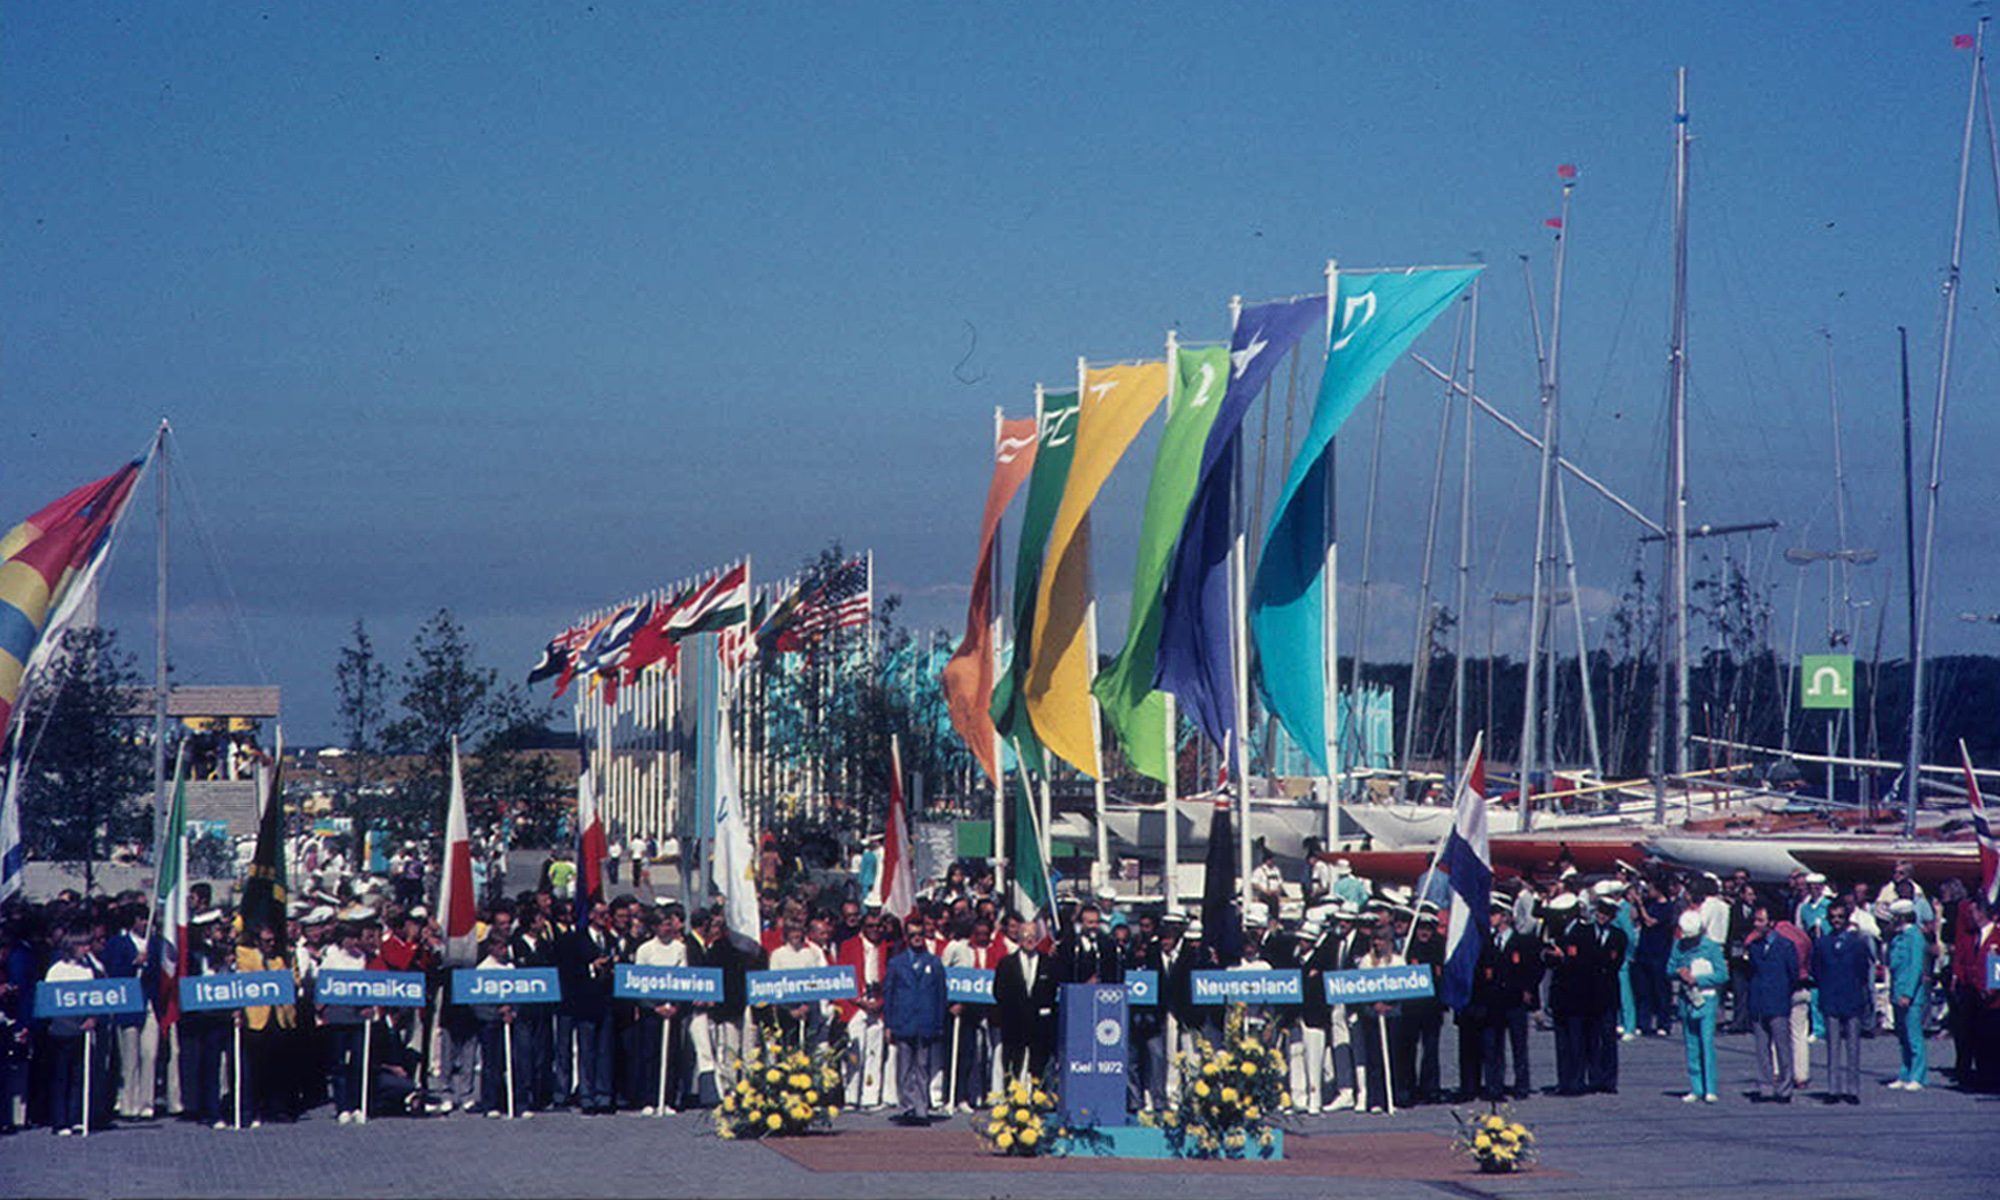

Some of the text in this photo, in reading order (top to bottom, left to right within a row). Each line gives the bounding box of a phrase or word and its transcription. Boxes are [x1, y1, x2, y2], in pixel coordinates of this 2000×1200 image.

[195, 980, 280, 1002] Italien
[319, 977, 423, 998] Jamaika
[470, 976, 547, 998] Japan
[624, 969, 715, 993] Jugoslawien
[749, 971, 855, 999] Jungferninseln
[946, 976, 993, 995] nada
[1196, 976, 1298, 997] Neuseeland
[1329, 970, 1429, 997] Niederlande
[55, 985, 127, 1007] Israel
[1070, 1060, 1123, 1074] Kiel 1972
